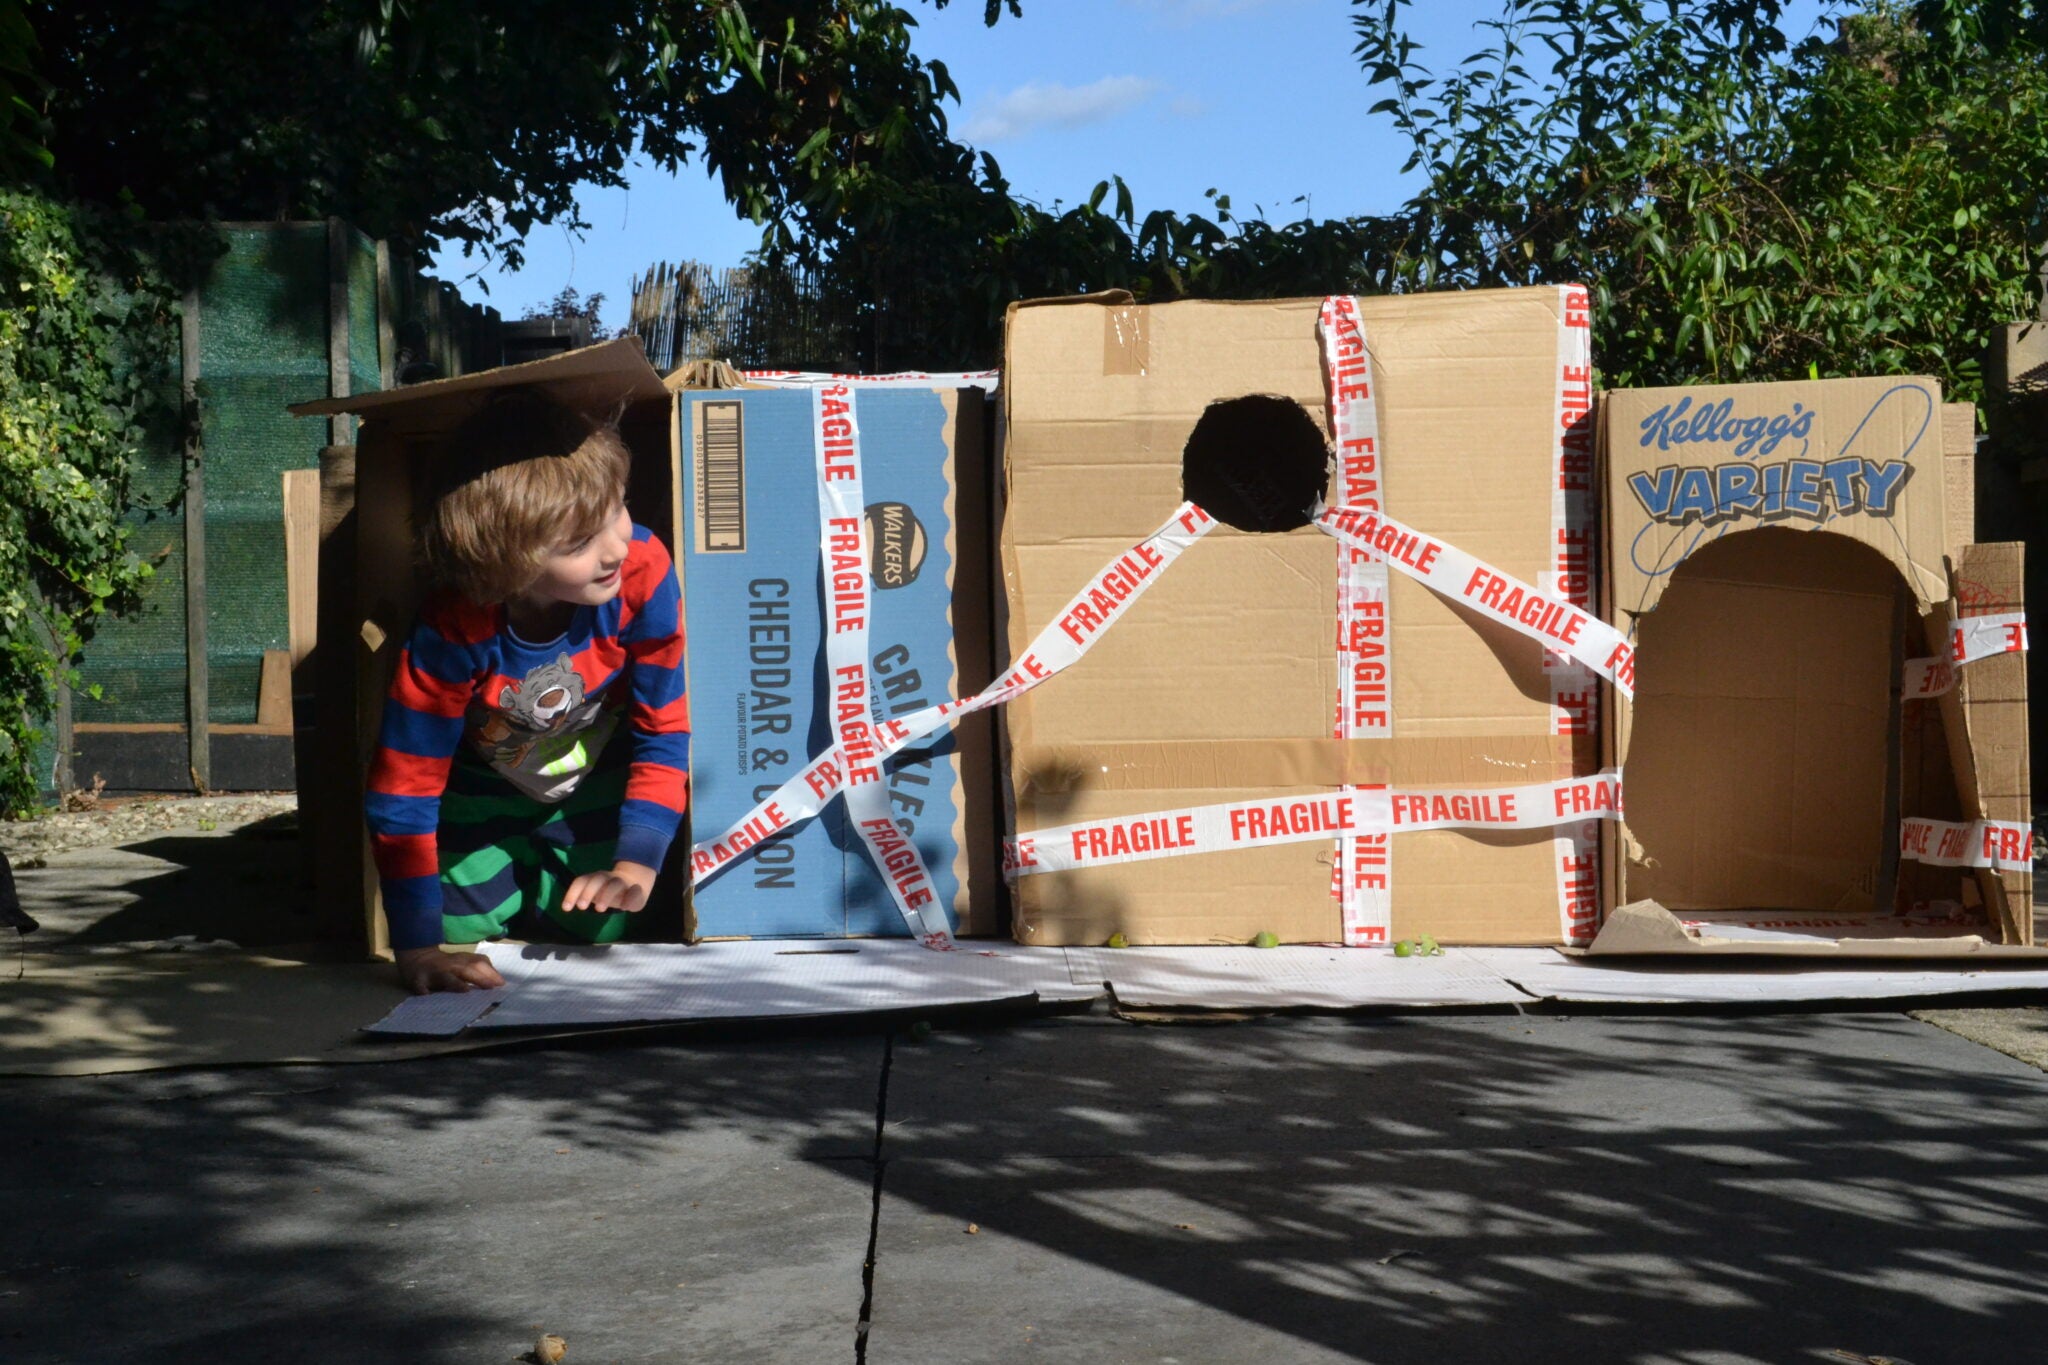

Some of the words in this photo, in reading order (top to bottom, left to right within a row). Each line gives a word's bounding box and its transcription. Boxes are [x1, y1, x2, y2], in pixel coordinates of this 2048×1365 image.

[1335, 296, 1369, 403] RAGILE
[821, 384, 856, 482] RAGILE
[1559, 365, 1591, 491] FRAGILE
[1639, 396, 1815, 457] Kellogg's
[1627, 456, 1915, 528] VARIETY
[829, 517, 865, 634] FRAGILE
[882, 505, 903, 585] WALKERS
[1321, 506, 1442, 575] FRAGILE
[1464, 566, 1587, 646] FRAGILE
[1059, 541, 1164, 645] FRAGILE
[748, 578, 792, 735] CHEDDAR
[1353, 602, 1387, 728] FRAGILE
[736, 693, 746, 724] FLAVOUR
[737, 725, 747, 750] POTATO
[836, 664, 881, 786] FRAGILE
[738, 751, 748, 776] CRISPS
[752, 747, 789, 772] &
[861, 818, 933, 911] FRAGILE
[1072, 815, 1195, 860] FRAGILE
[1230, 798, 1355, 841] FRAGILE
[1391, 794, 1517, 825] FRAGILE
